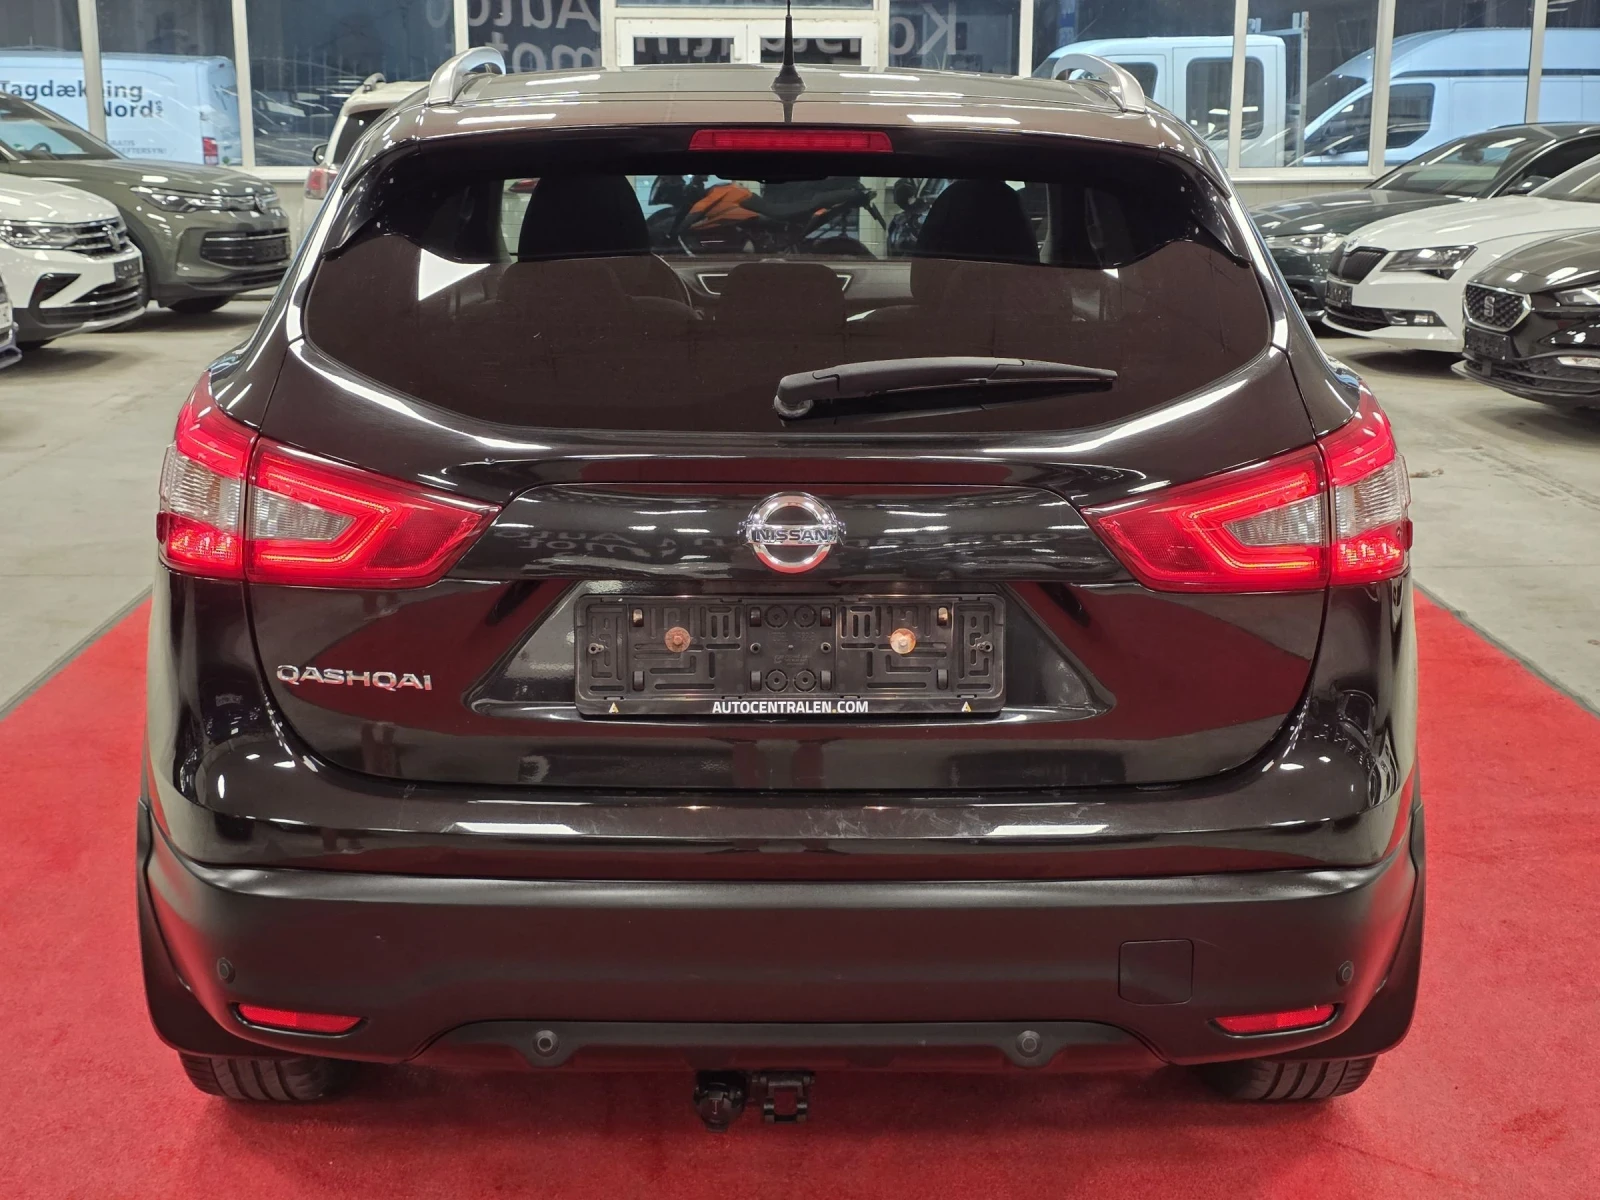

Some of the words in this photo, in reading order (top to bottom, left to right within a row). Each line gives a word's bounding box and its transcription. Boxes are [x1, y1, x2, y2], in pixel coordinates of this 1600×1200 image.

[0, 79, 143, 103] Tagdæking
[752, 529, 828, 541] NISSAN
[276, 664, 433, 692] QASHQAI
[711, 700, 869, 714] AUTOCENTRALEN.COM
